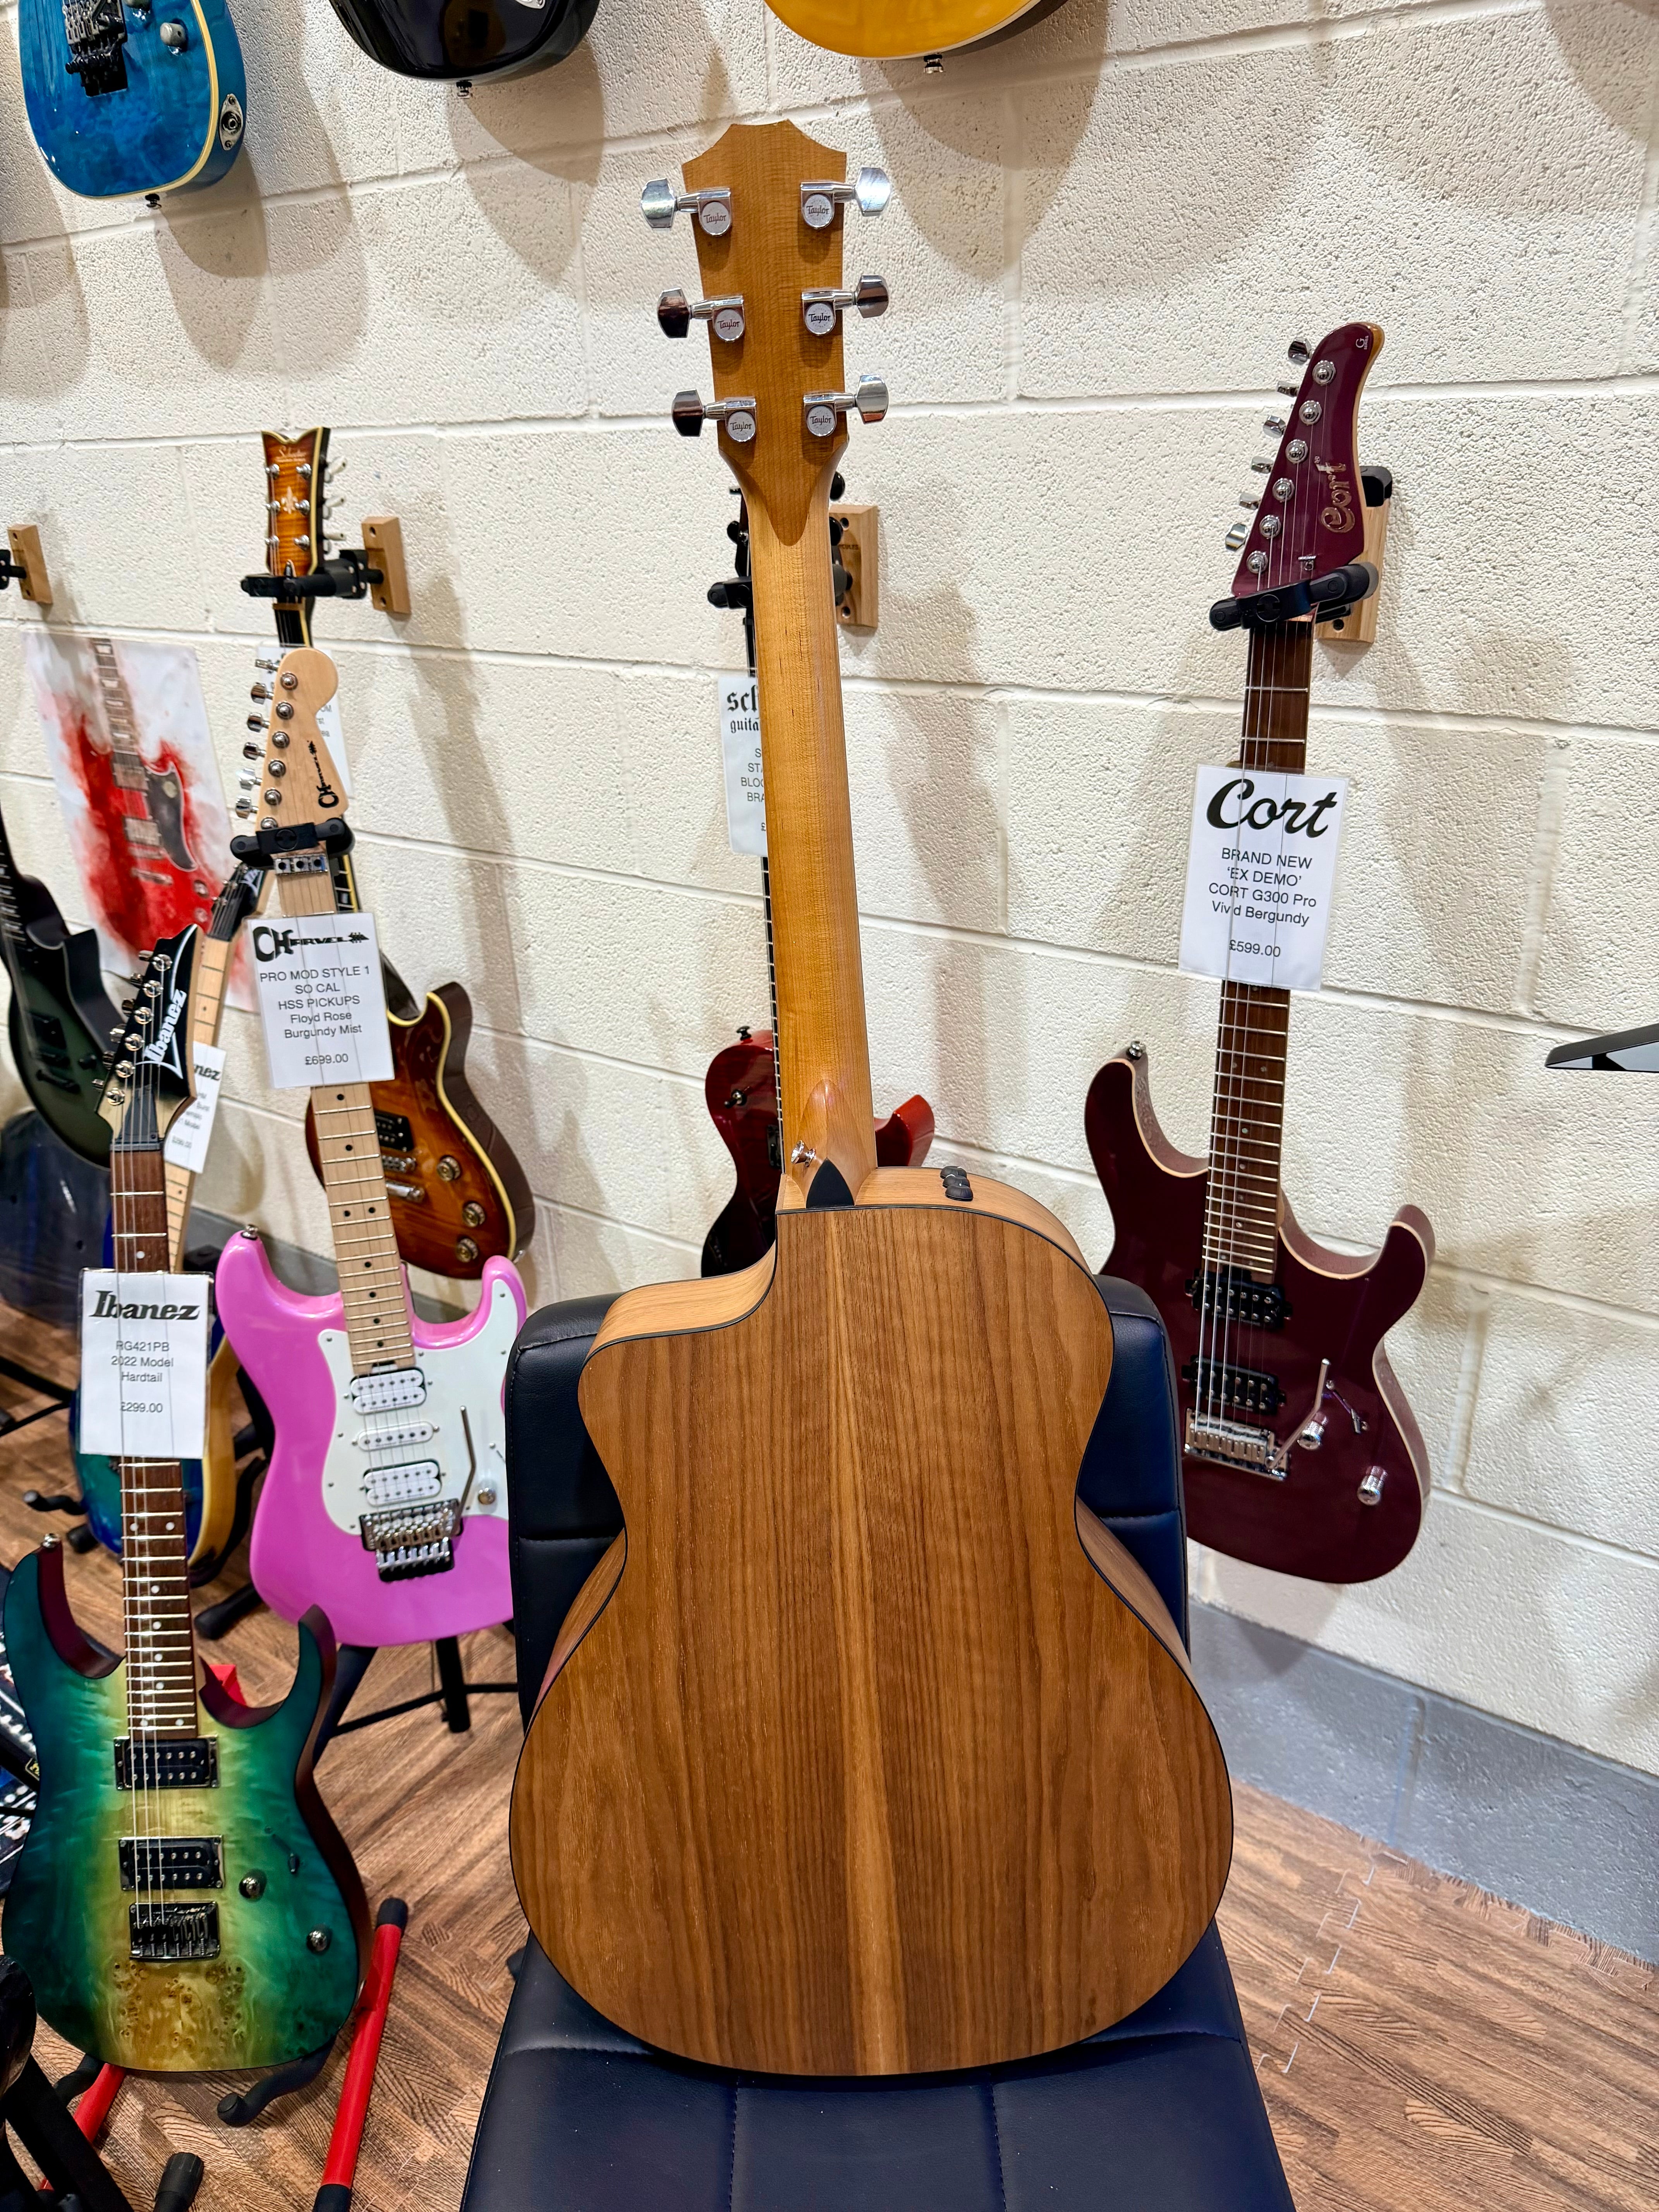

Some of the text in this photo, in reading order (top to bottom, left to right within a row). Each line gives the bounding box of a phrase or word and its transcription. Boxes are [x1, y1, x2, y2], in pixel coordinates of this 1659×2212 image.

[806, 205, 830, 216] Taylor
[703, 213, 727, 225] Taylor
[717, 319, 740, 330] Taylor
[809, 313, 831, 323] Taylor
[730, 421, 752, 432] Taylor
[809, 415, 831, 425] Taylor
[1316, 462, 1355, 533] Cort
[730, 718, 759, 733] guita
[1206, 778, 1338, 838] Cort
[1221, 848, 1312, 869] BRAND NEW
[1209, 883, 1317, 907] CORT G300 Pro
[1212, 901, 1309, 927] Vivd Bergundy
[1228, 939, 1281, 957] £599.00
[260, 966, 370, 982] PRO MOD STYLE 1
[295, 982, 341, 994] SO CAL
[278, 995, 361, 1010] HSS PICKUPS
[290, 1012, 352, 1025] Floyd Rose
[144, 989, 187, 1063] Ibanez
[284, 1025, 362, 1039] Burgundy Mist
[305, 1053, 349, 1066] £699.00
[194, 1063, 221, 1081] nez
[89, 1290, 200, 1321] Ibanez
[115, 1340, 170, 1352] RG421PB
[111, 1355, 174, 1367] 2022 Model
[122, 1371, 163, 1382] Hardtail
[120, 1401, 163, 1413] £299.00
